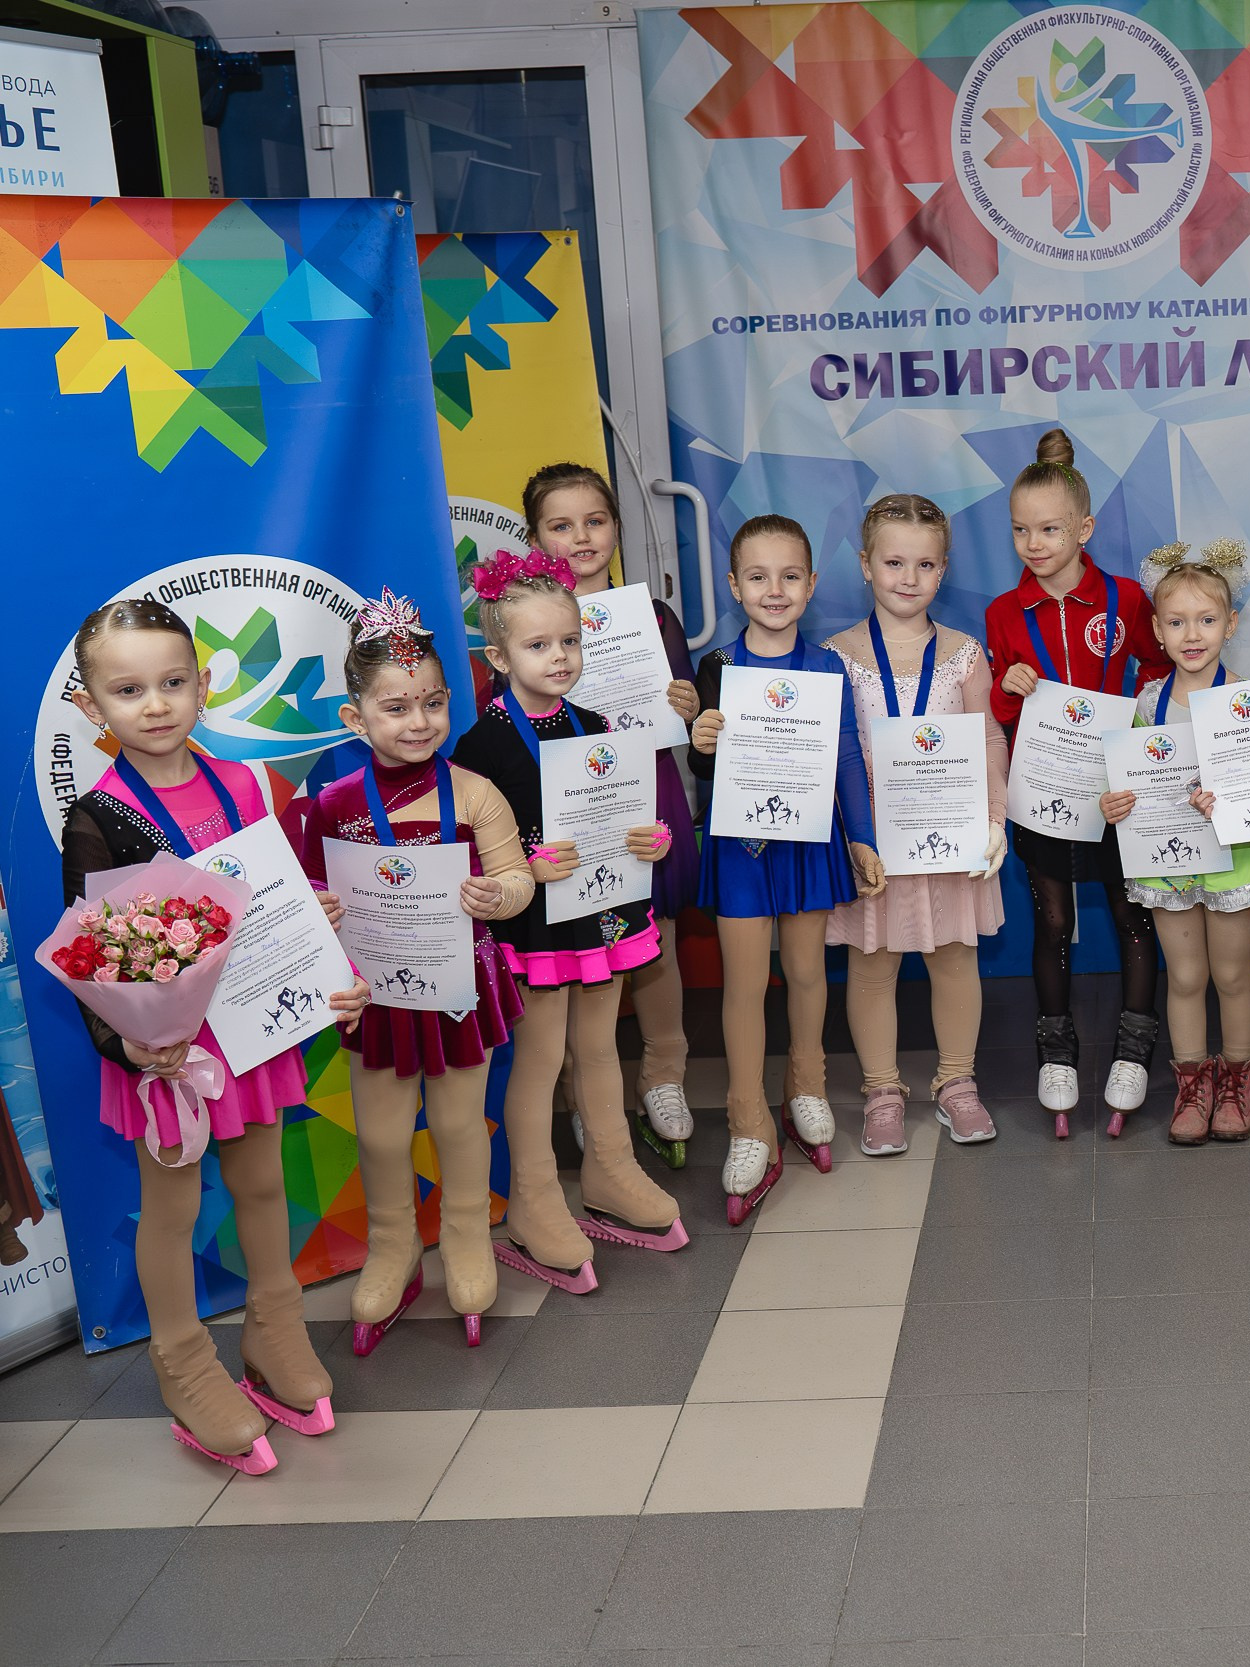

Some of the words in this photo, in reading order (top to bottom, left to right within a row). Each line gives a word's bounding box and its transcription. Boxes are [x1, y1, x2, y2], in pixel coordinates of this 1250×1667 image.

[602, 5, 611, 17] 9
[960, 70, 989, 144] РЕГИОНАЛЬНАЯ
[981, 18, 1048, 72] ОБЩЕСТВЕННАЯ
[1047, 12, 1180, 71] ФИЗКУЛЬТУРНО-СПОРТИВНАЯ
[1173, 68, 1204, 138] ОРГАНИЗАЦИЯ
[1, 74, 57, 97] ВОДА
[961, 150, 993, 211] «ФЕДЕРАЦИЯ
[987, 206, 1034, 249] ФИГУРНОГО
[1032, 240, 1075, 262] КАТАНИЯ
[1076, 249, 1090, 262] НА
[1090, 240, 1133, 261] КОНЬКАХ
[1131, 187, 1191, 248] НОВОСИБИРСКОЙ
[1182, 142, 1204, 191] ОБЛАСТИ»
[712, 308, 928, 335] СОРЕВНОВАНИЯ
[935, 307, 972, 328] ПО
[978, 300, 1141, 327] ФИГУРНОМУ
[809, 326, 1206, 401] СИБИРСКИЙ
[158, 567, 301, 605] ОБЩЕСТВЕННАЯ
[302, 578, 360, 625] ОРГАНИ
[589, 645, 622, 658] письмо
[740, 713, 821, 726] Благодарственное
[764, 726, 797, 735] письмо
[1038, 721, 1102, 742] Благодарственн
[1057, 736, 1088, 748] письмо
[892, 758, 969, 768] Благодарственное
[915, 768, 947, 776] письмо
[1150, 775, 1181, 784] письмо
[564, 778, 640, 798] Благодарственное
[588, 793, 617, 804] письмо
[352, 887, 448, 902] Благодарственное
[380, 902, 419, 911] письмо
[0, 1253, 70, 1297] ЧИСТО
